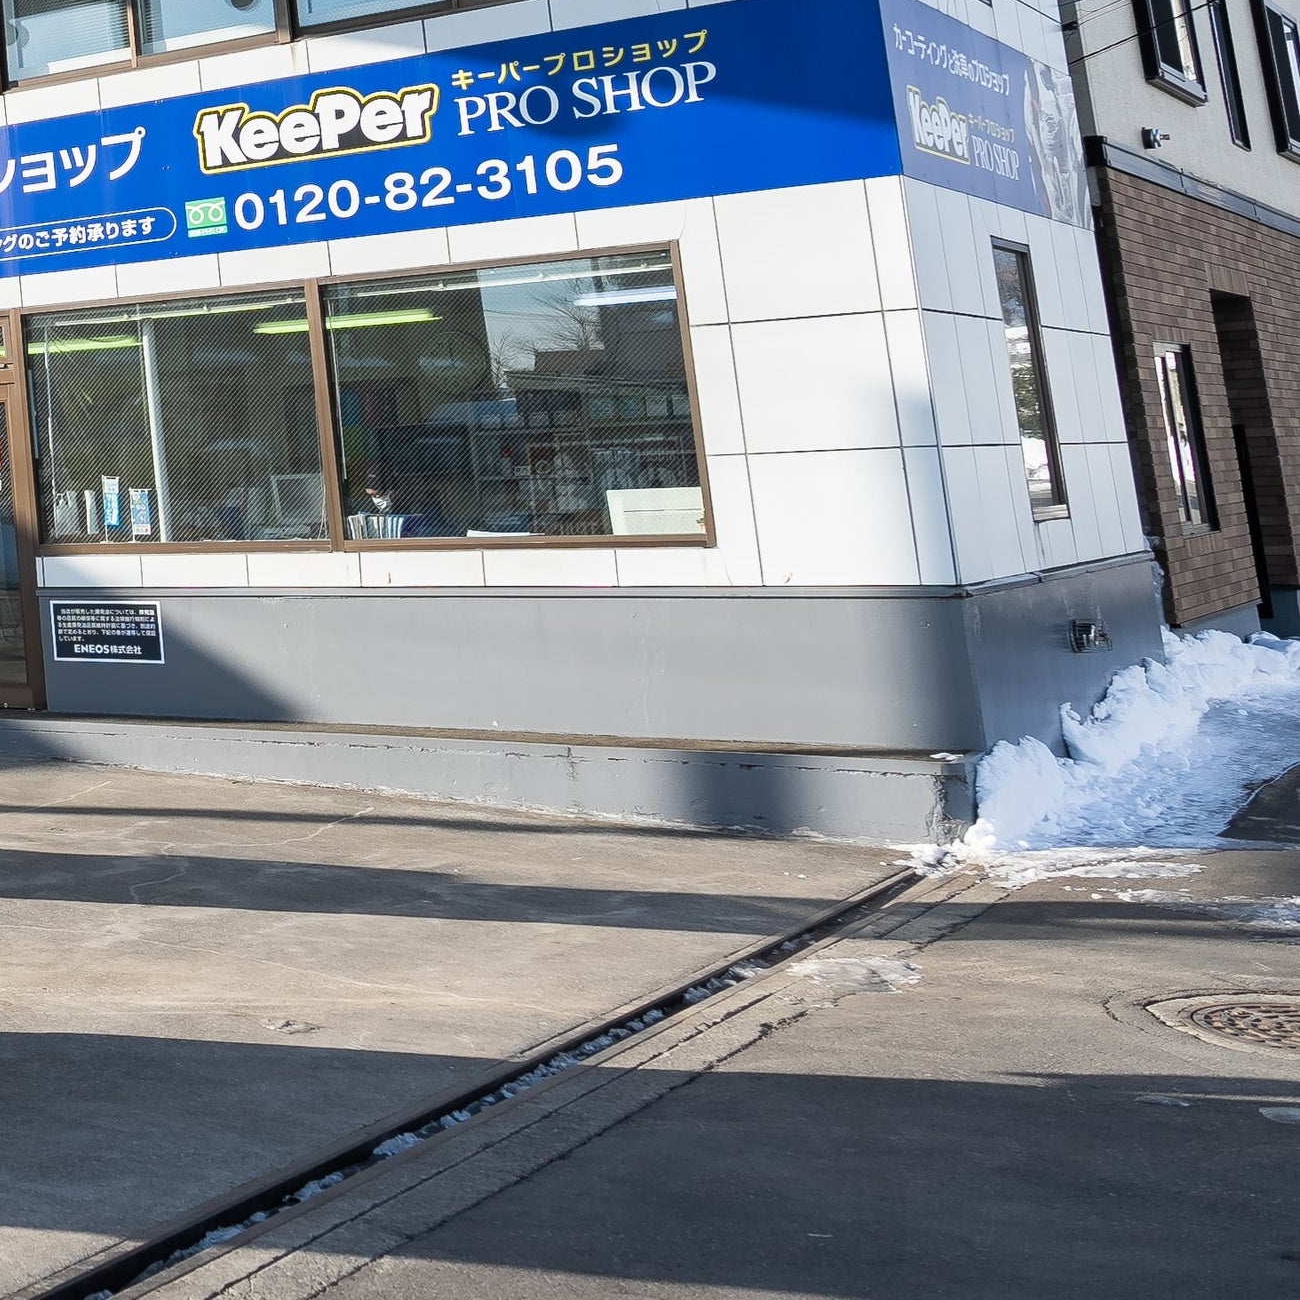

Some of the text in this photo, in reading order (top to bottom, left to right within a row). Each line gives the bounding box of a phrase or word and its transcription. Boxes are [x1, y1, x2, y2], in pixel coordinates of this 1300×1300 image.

[450, 29, 709, 90] キーパープロショップ
[195, 84, 438, 171] KeePer
[454, 60, 717, 137] PRO SHOP
[907, 86, 970, 163] KeePer
[233, 143, 624, 231] 0120-82-3105
[971, 134, 1020, 180] PRO SHOP
[73, 644, 143, 655] ENEOS株式会社
